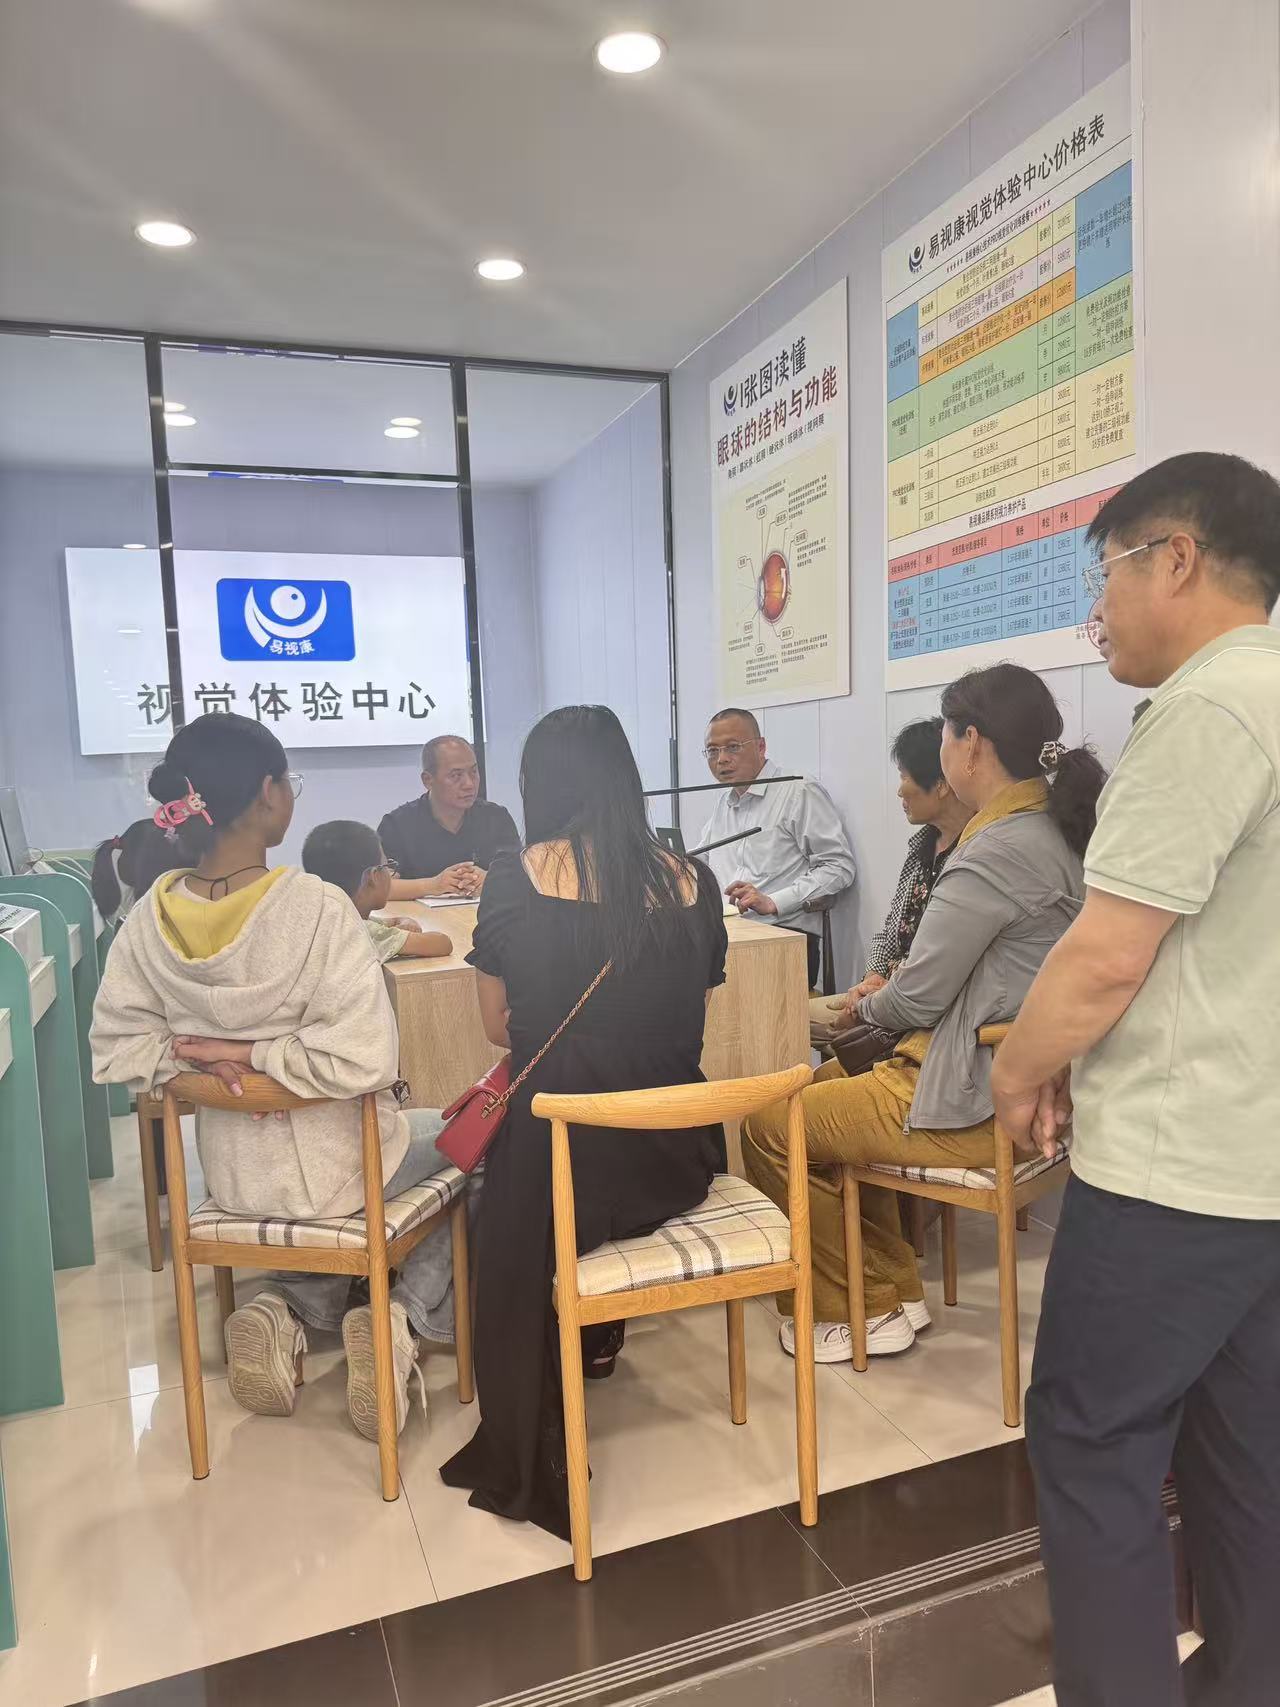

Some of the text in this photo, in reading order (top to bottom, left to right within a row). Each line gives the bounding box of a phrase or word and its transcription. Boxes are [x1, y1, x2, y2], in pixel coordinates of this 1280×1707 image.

[928, 113, 1105, 260] 易视康视觉体验中心价格表
[718, 366, 837, 466] 眼球的结构与功能
[269, 639, 315, 656] 易视康
[137, 680, 436, 726] 视觉体验中心
